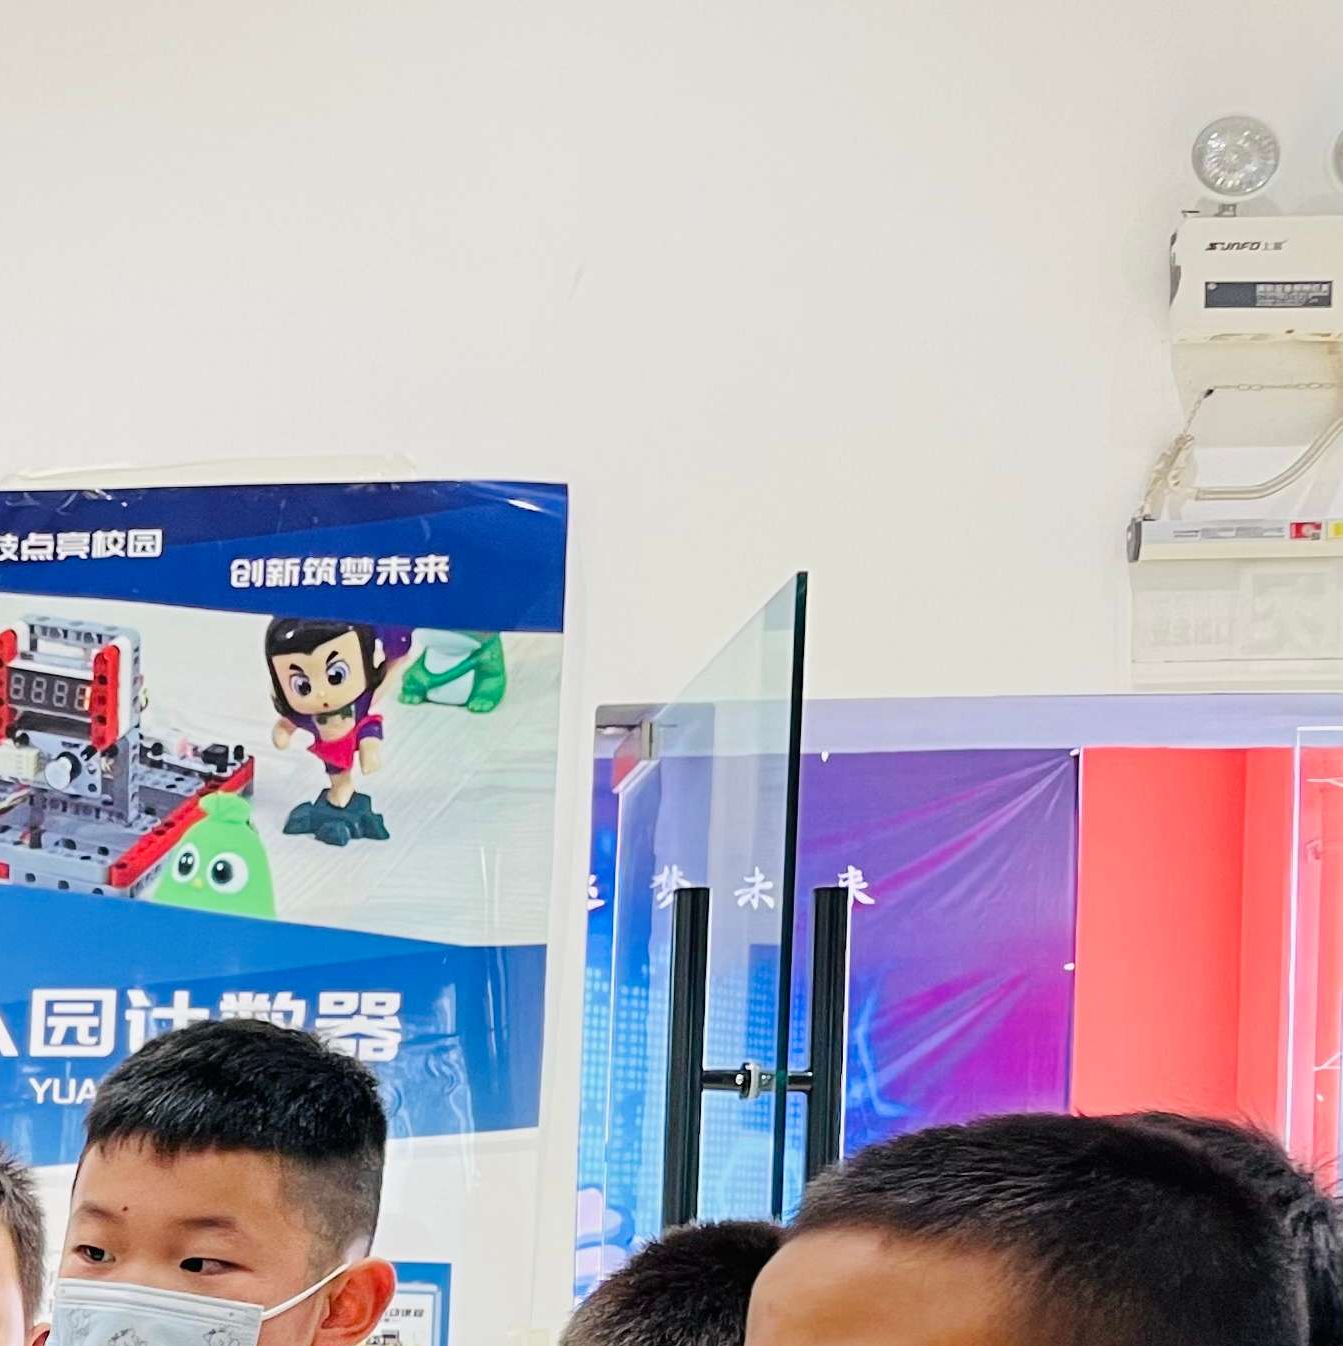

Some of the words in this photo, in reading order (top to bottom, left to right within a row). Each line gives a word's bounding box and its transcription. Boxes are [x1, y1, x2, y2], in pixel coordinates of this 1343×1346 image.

[230, 554, 450, 588] 创新筑梦未来
